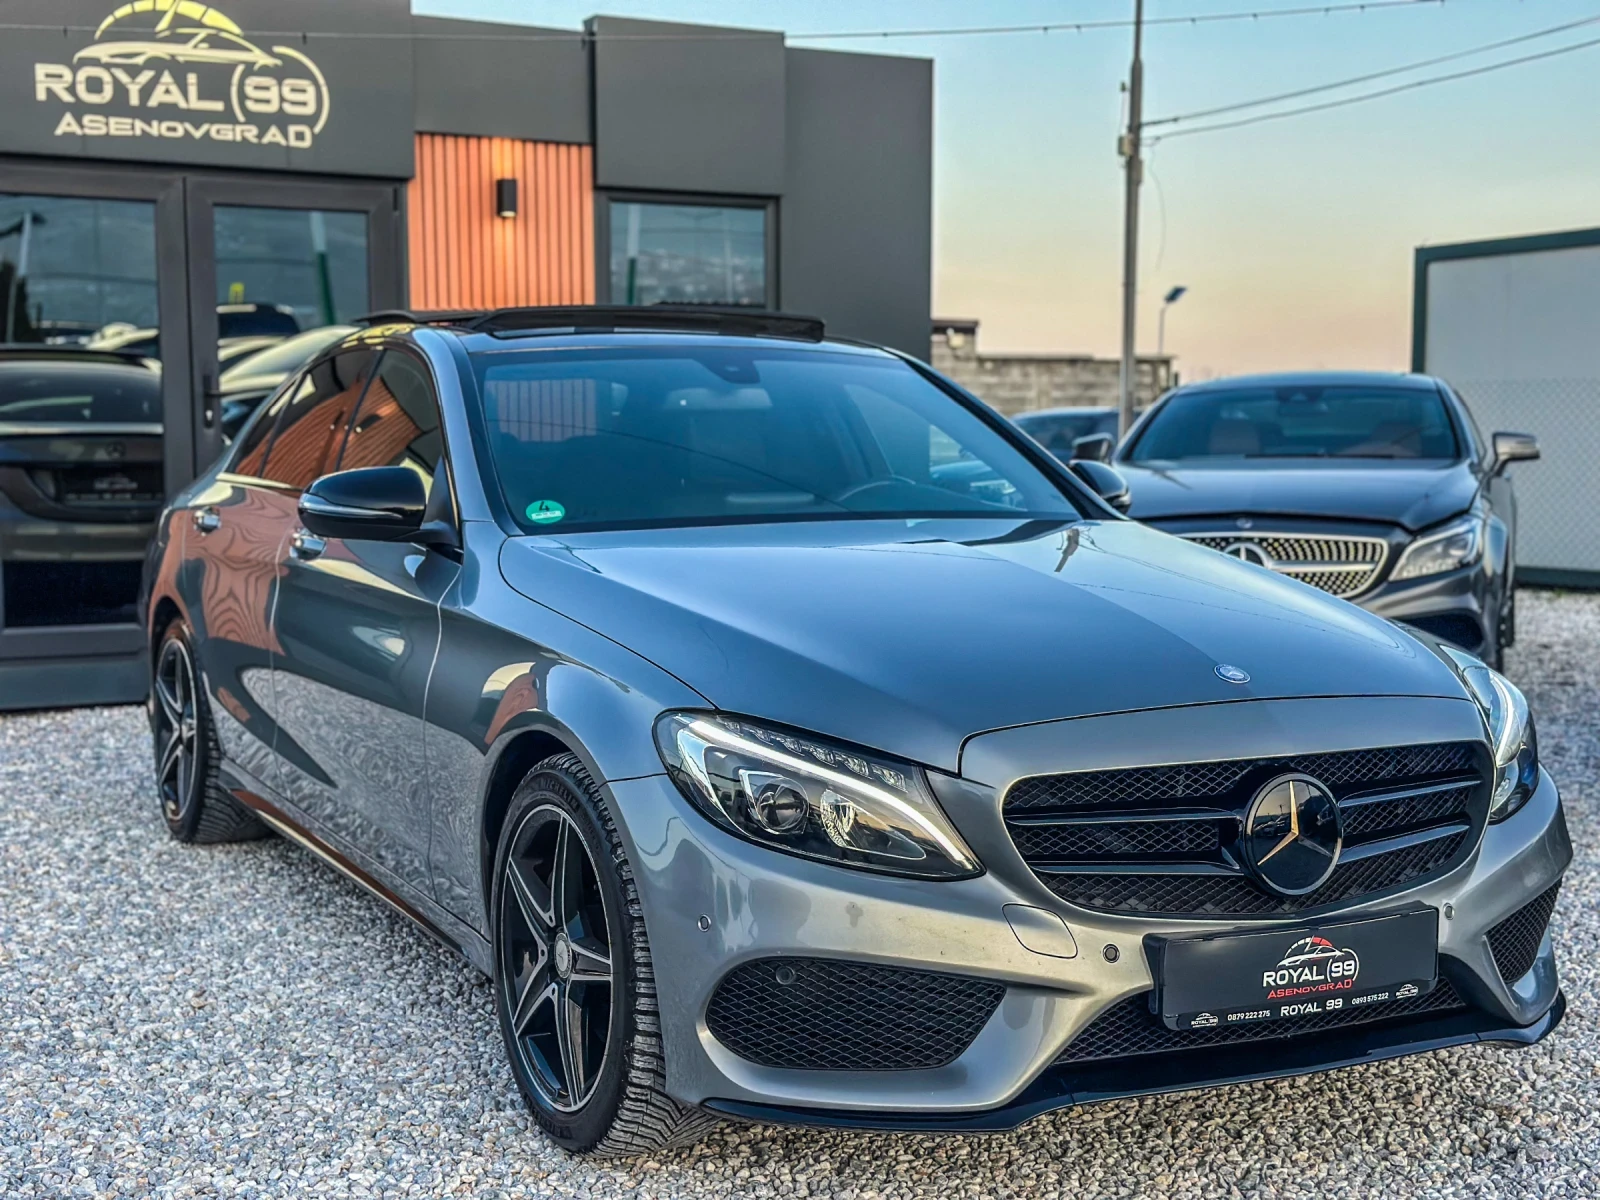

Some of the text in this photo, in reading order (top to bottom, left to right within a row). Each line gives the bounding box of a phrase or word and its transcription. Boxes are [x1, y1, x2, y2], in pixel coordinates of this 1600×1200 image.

[34, 63, 225, 112] ROYAL
[54, 111, 312, 149] ASENOVGRAD
[1263, 965, 1325, 987] ROYAL
[1267, 978, 1352, 999] ASENOVGRAD
[1280, 998, 1343, 1017] ROYAL 99
